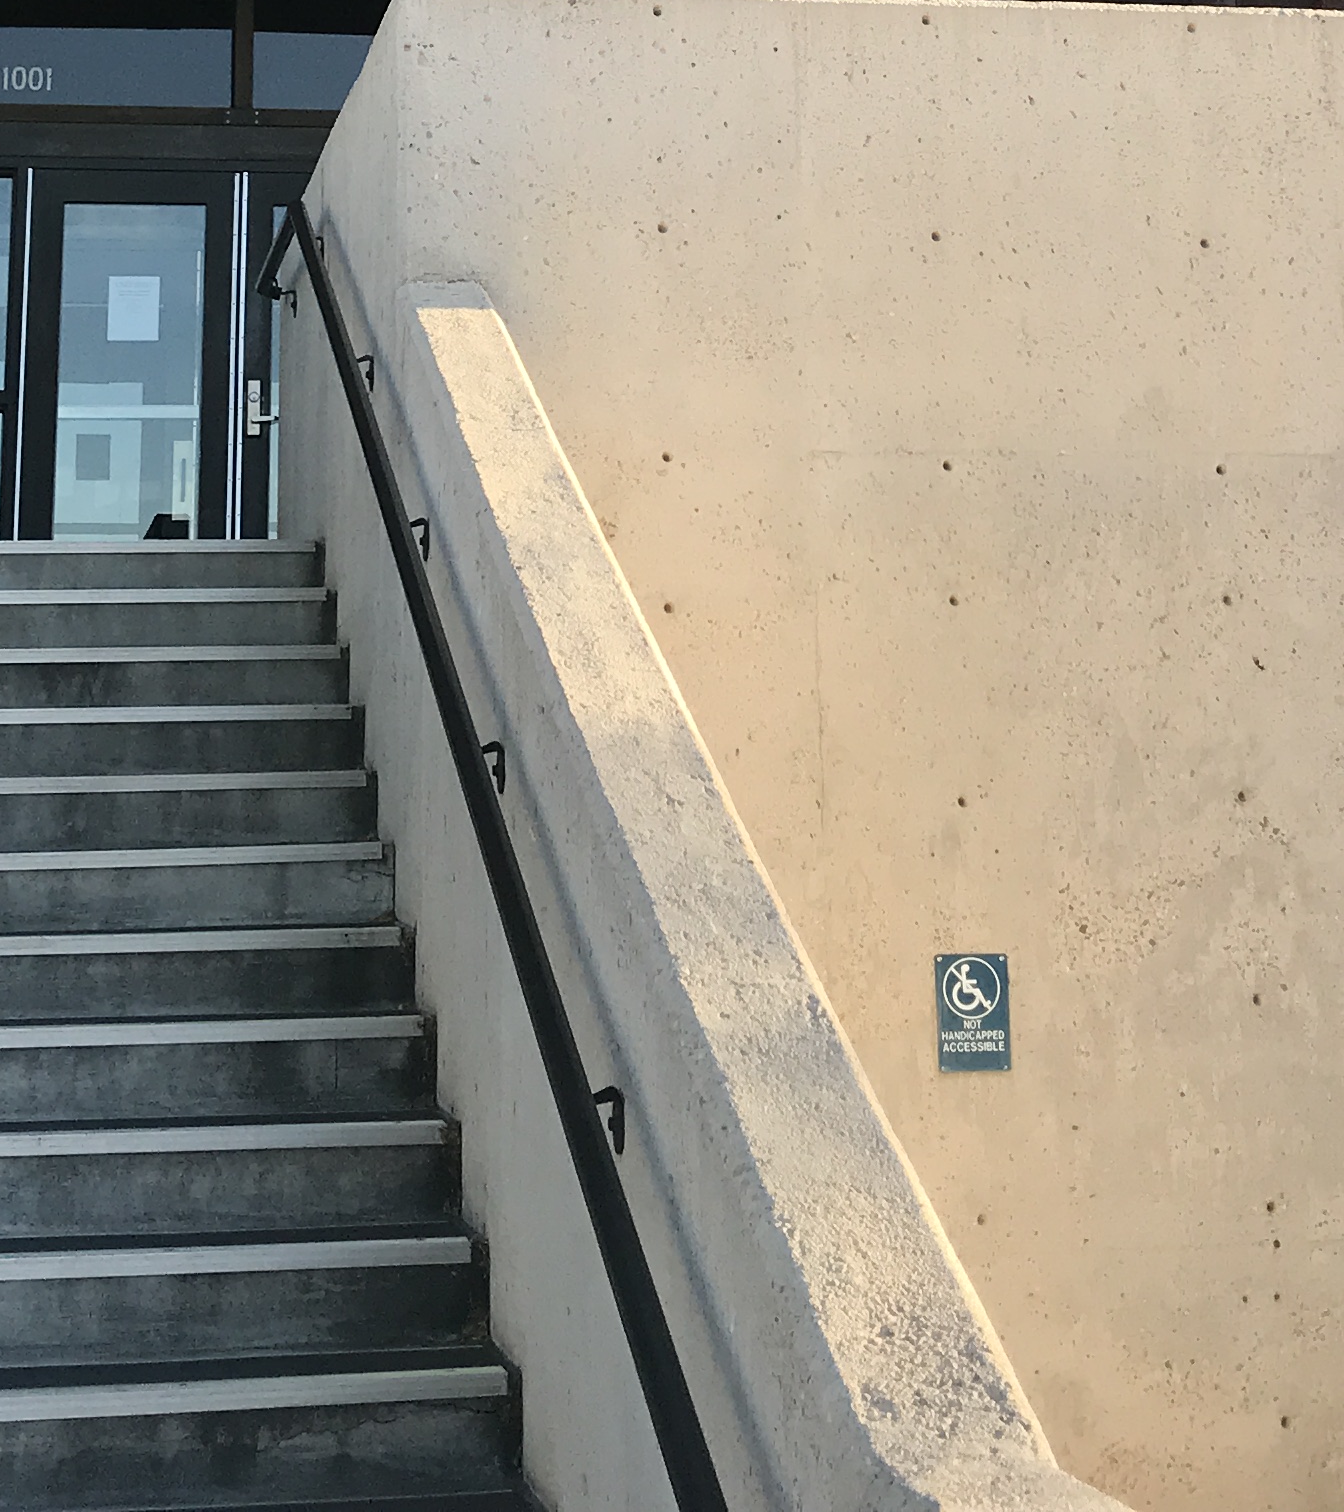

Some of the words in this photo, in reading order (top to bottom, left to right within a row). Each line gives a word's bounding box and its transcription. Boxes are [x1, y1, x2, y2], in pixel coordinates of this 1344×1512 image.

[2, 66, 53, 91] 1001
[963, 1020, 982, 1029] NOT
[941, 1030, 1005, 1041] HANDICAPPED
[942, 1041, 1006, 1053] ACCESSIBLE
